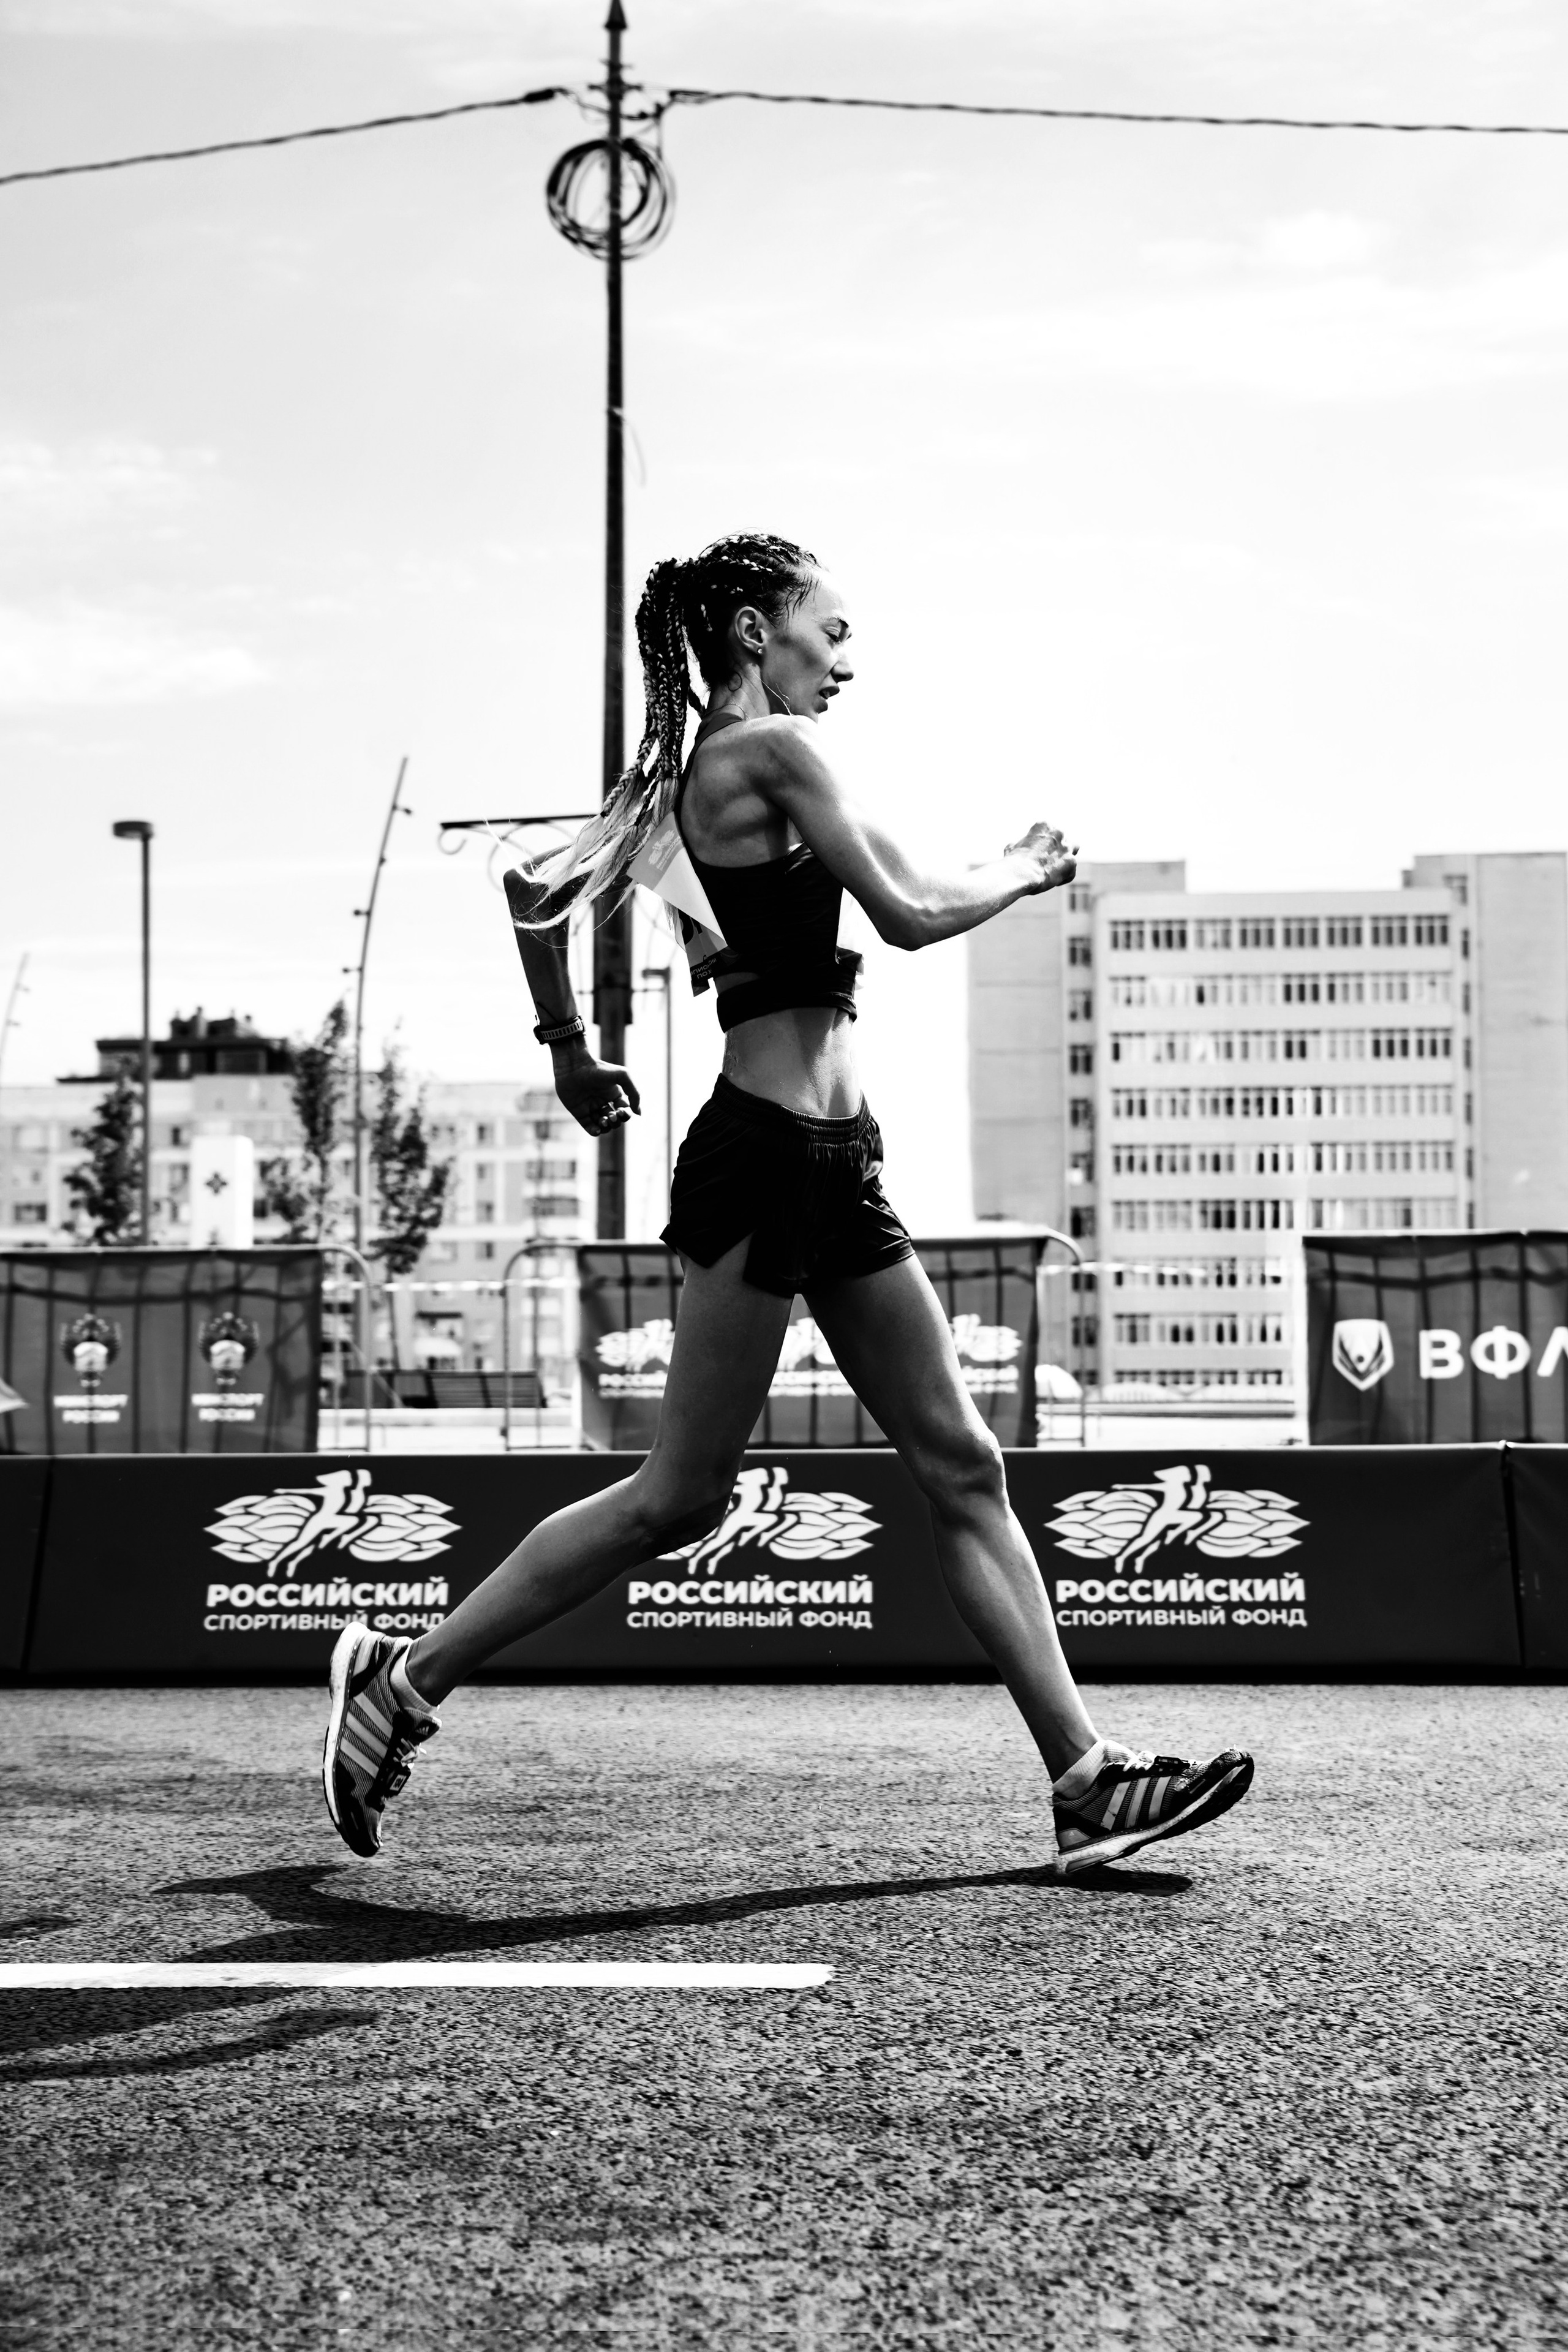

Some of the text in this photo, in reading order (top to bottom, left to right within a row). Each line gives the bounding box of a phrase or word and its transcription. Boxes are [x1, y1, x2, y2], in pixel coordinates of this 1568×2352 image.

[206, 1576, 448, 1607] РОССИЙСКИЙ
[628, 1574, 873, 1605] РОССИЙСКИЙ
[1056, 1572, 1306, 1603] РОССИЙСКИЙ
[374, 1613, 445, 1632] ФОНД
[627, 1607, 873, 1629] СПОРТИВНЫЙ ФОНД
[1056, 1605, 1308, 1627] СПОРТИВНЫЙ ФОНД
